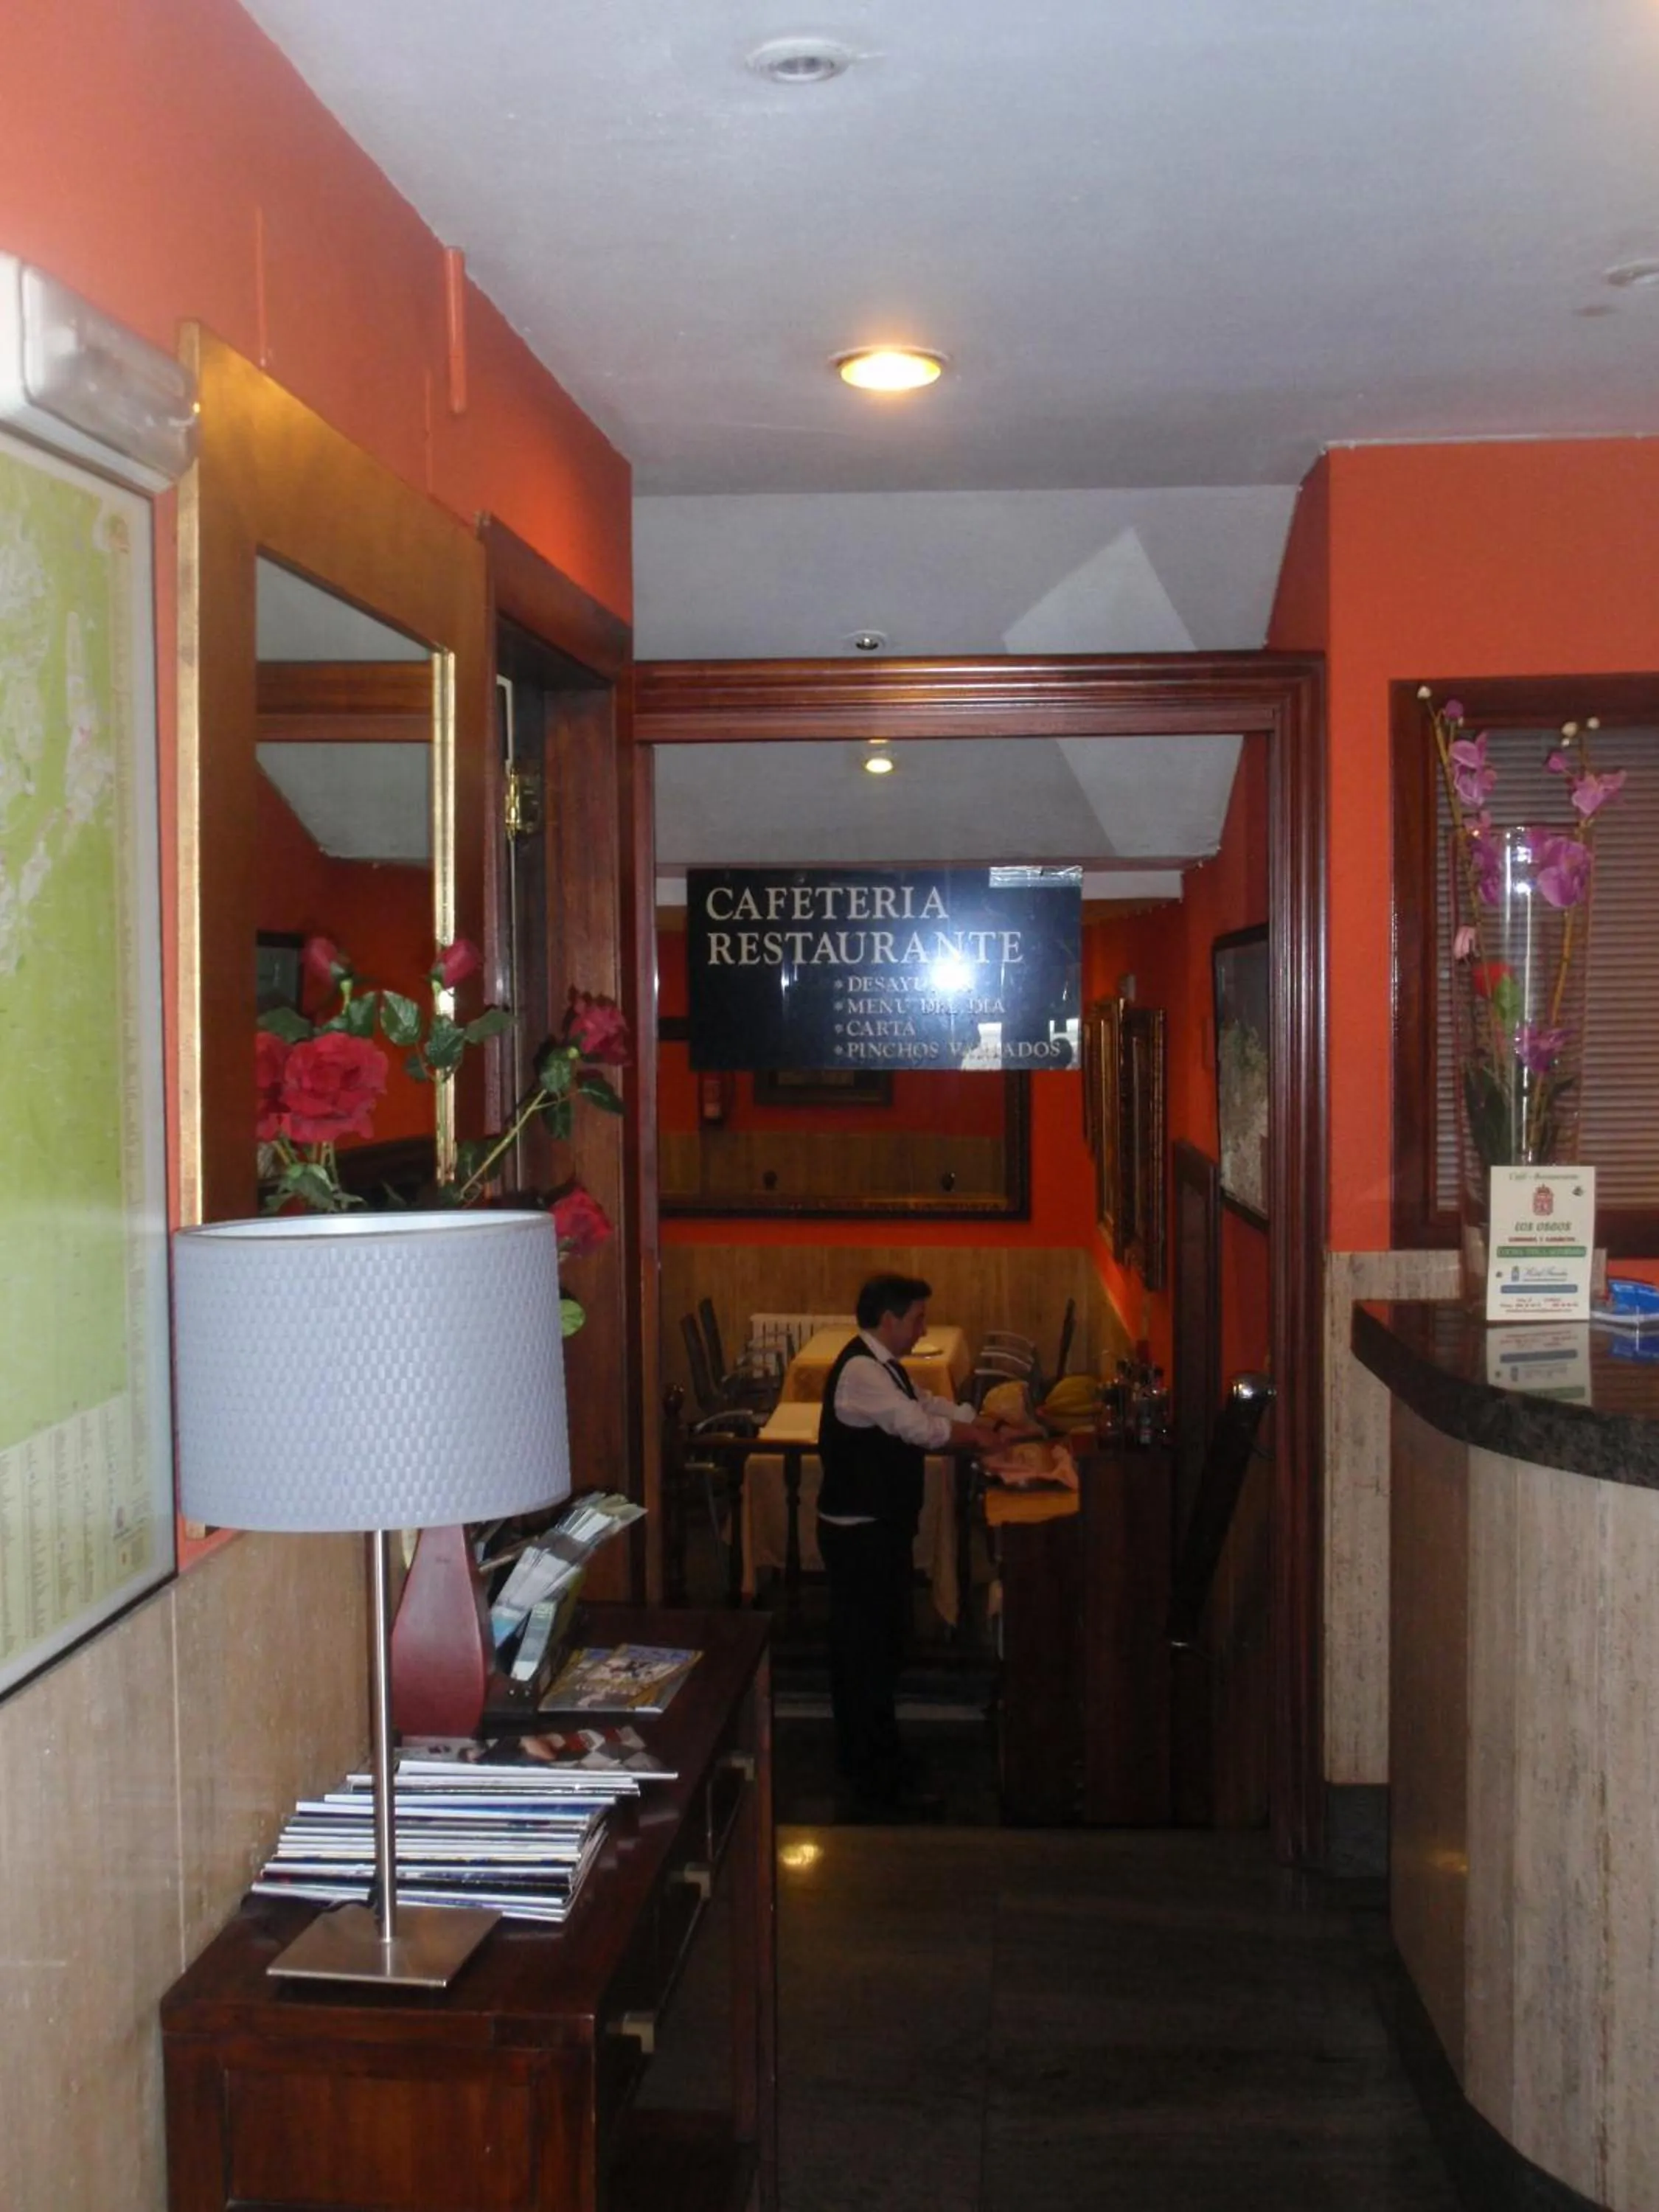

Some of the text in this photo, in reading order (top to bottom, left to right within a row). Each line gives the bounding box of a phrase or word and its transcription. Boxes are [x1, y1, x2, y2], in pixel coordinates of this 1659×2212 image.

[705, 886, 949, 921] CAFETERIA
[707, 931, 1025, 965] RESTAURANTE
[847, 976, 975, 992] DESAYU
[846, 1020, 916, 1037] CARTA
[847, 1041, 1061, 1059] PINCHOS VAADOS
